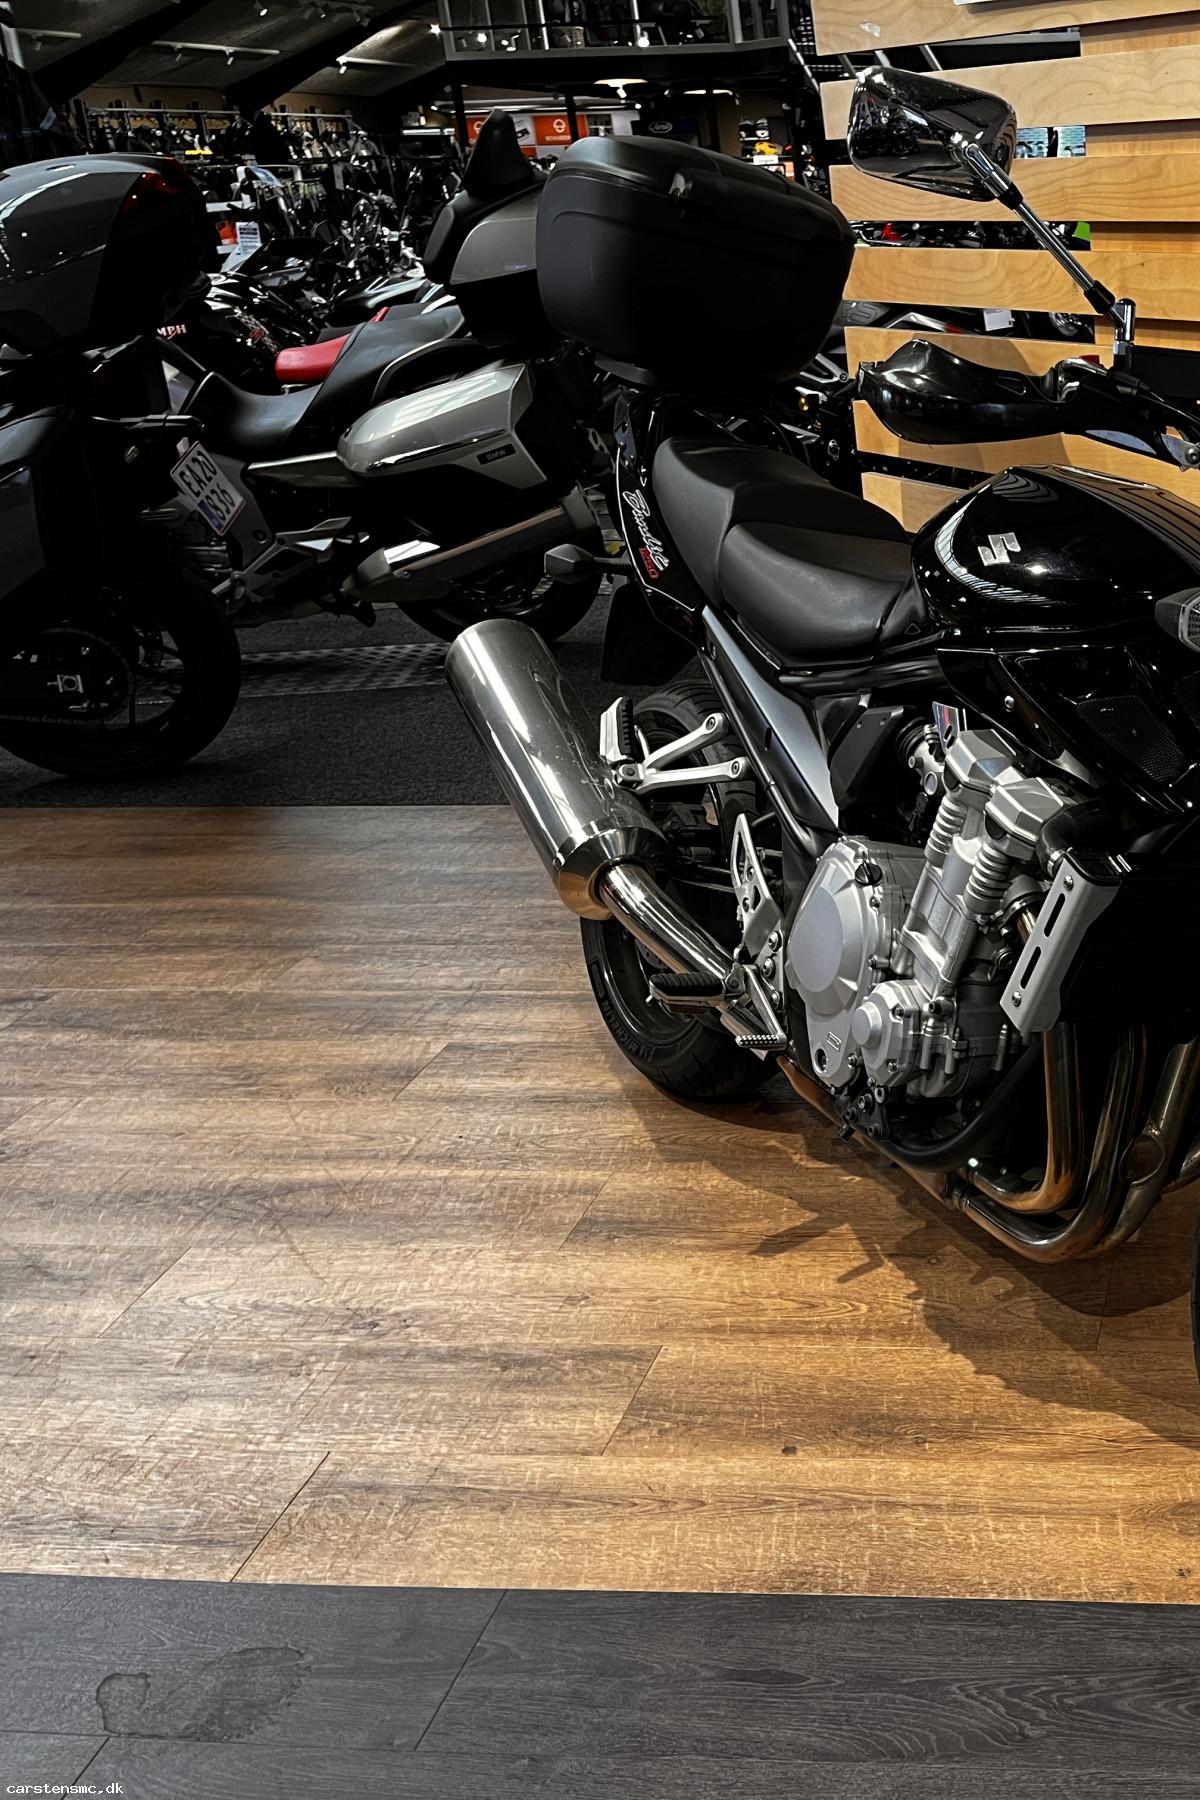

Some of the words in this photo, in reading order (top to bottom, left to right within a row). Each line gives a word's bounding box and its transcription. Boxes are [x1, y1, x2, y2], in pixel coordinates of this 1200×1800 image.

[178, 451, 218, 498] EA20
[205, 482, 236, 521] 836
[600, 999, 641, 1053] MICHELIN
